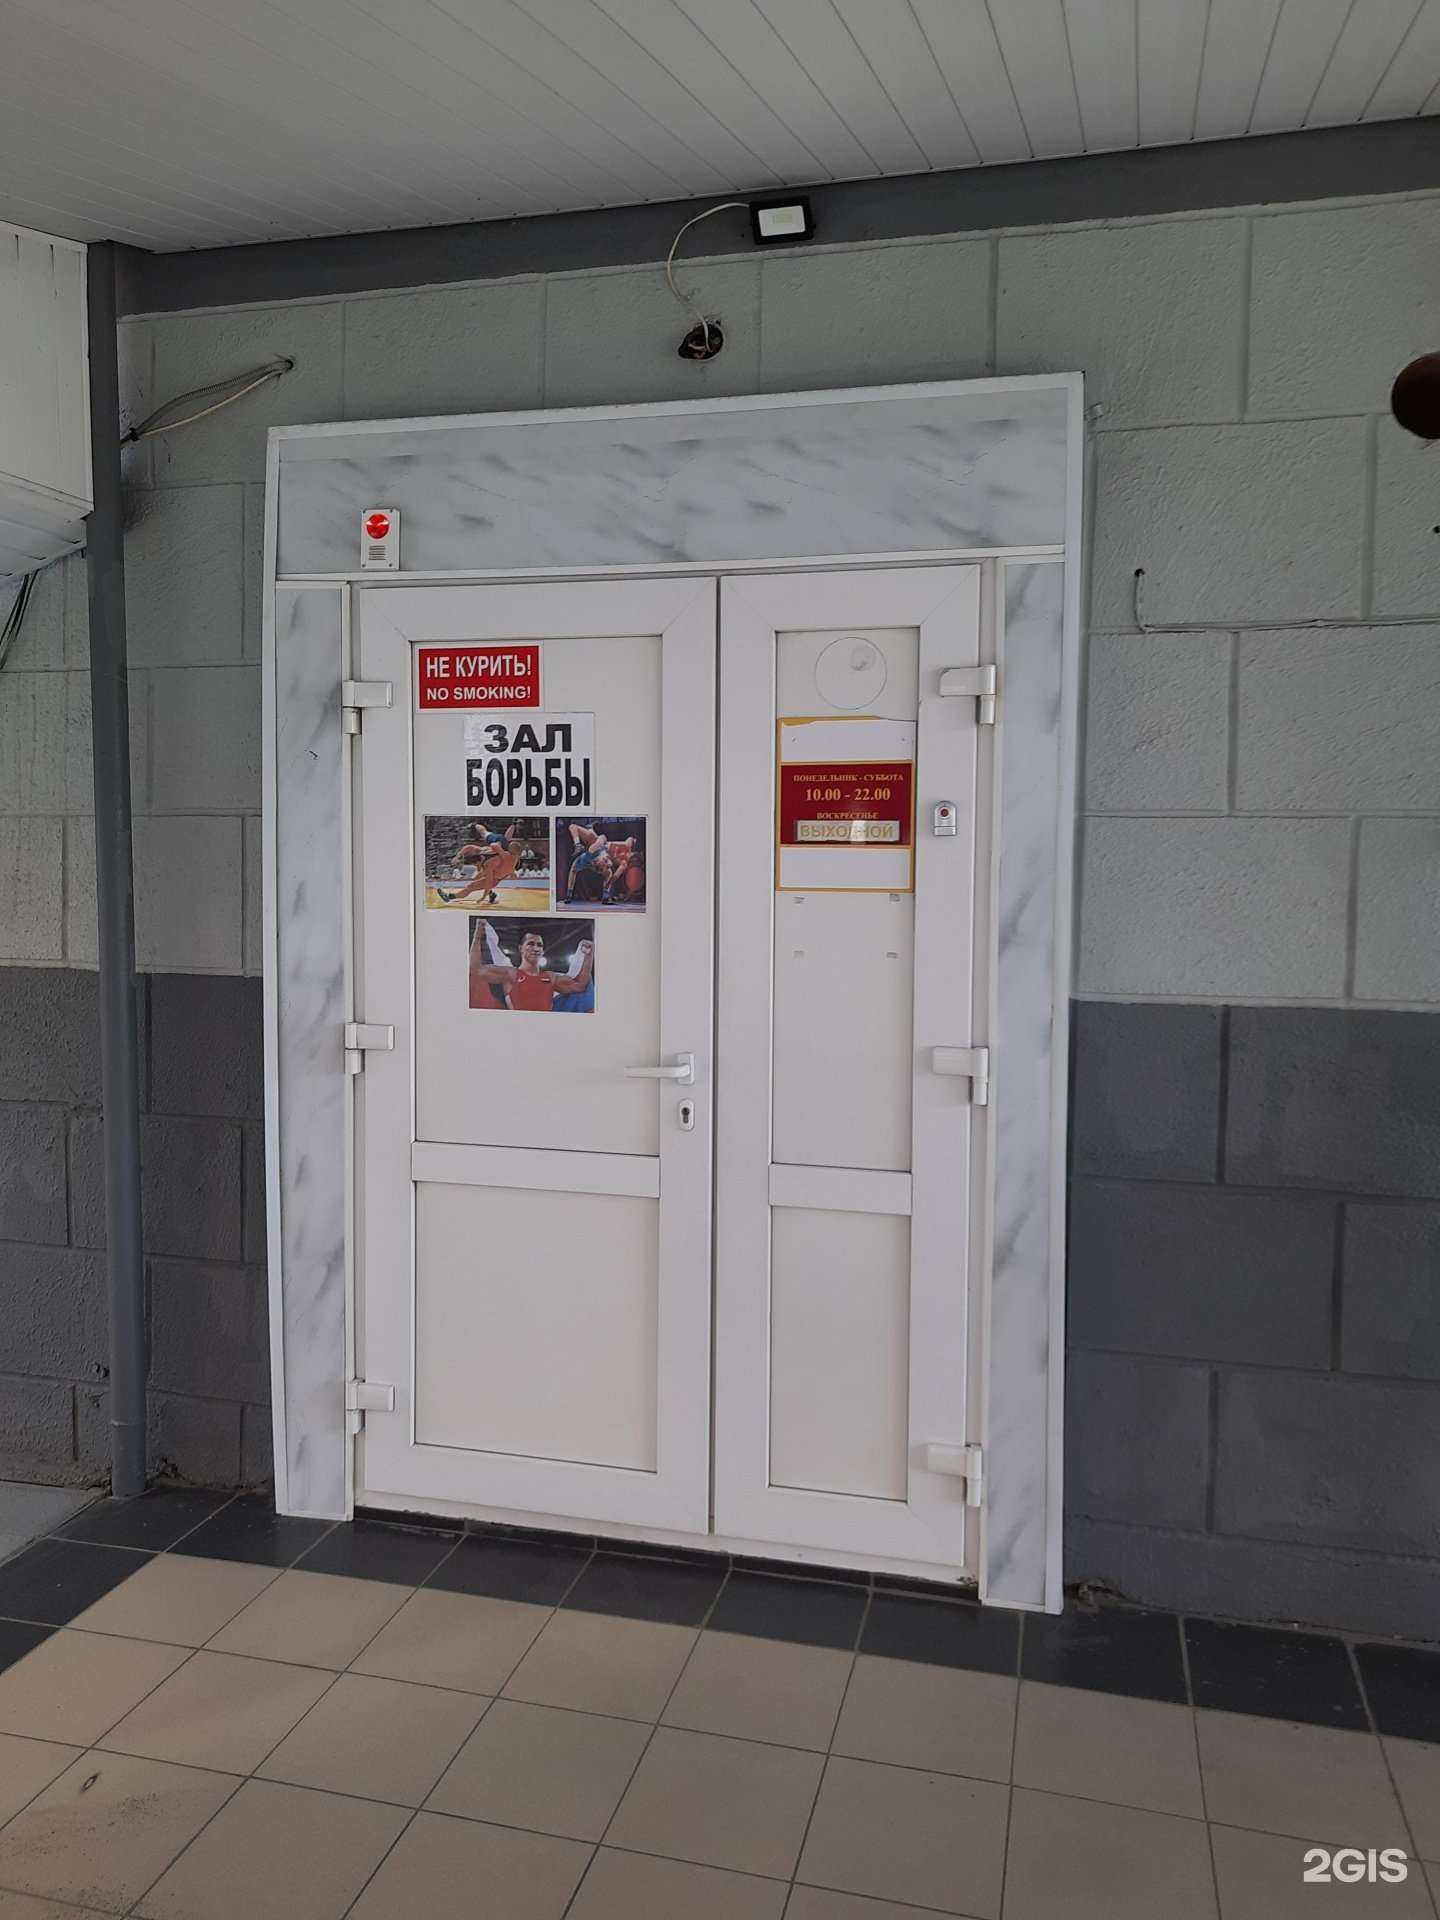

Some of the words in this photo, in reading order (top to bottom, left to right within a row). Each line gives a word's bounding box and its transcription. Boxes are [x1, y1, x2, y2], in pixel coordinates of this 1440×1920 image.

[426, 656, 450, 678] НЕ
[455, 654, 532, 678] КУРИТЬ!
[426, 687, 449, 701] NO
[453, 686, 531, 700] SMOKING!
[484, 723, 572, 753] ЗАЛ
[466, 758, 591, 807] БОРЬБЫ
[863, 774, 904, 782] СУББОТА
[805, 788, 841, 801] 10.00
[854, 788, 891, 801] 22.00
